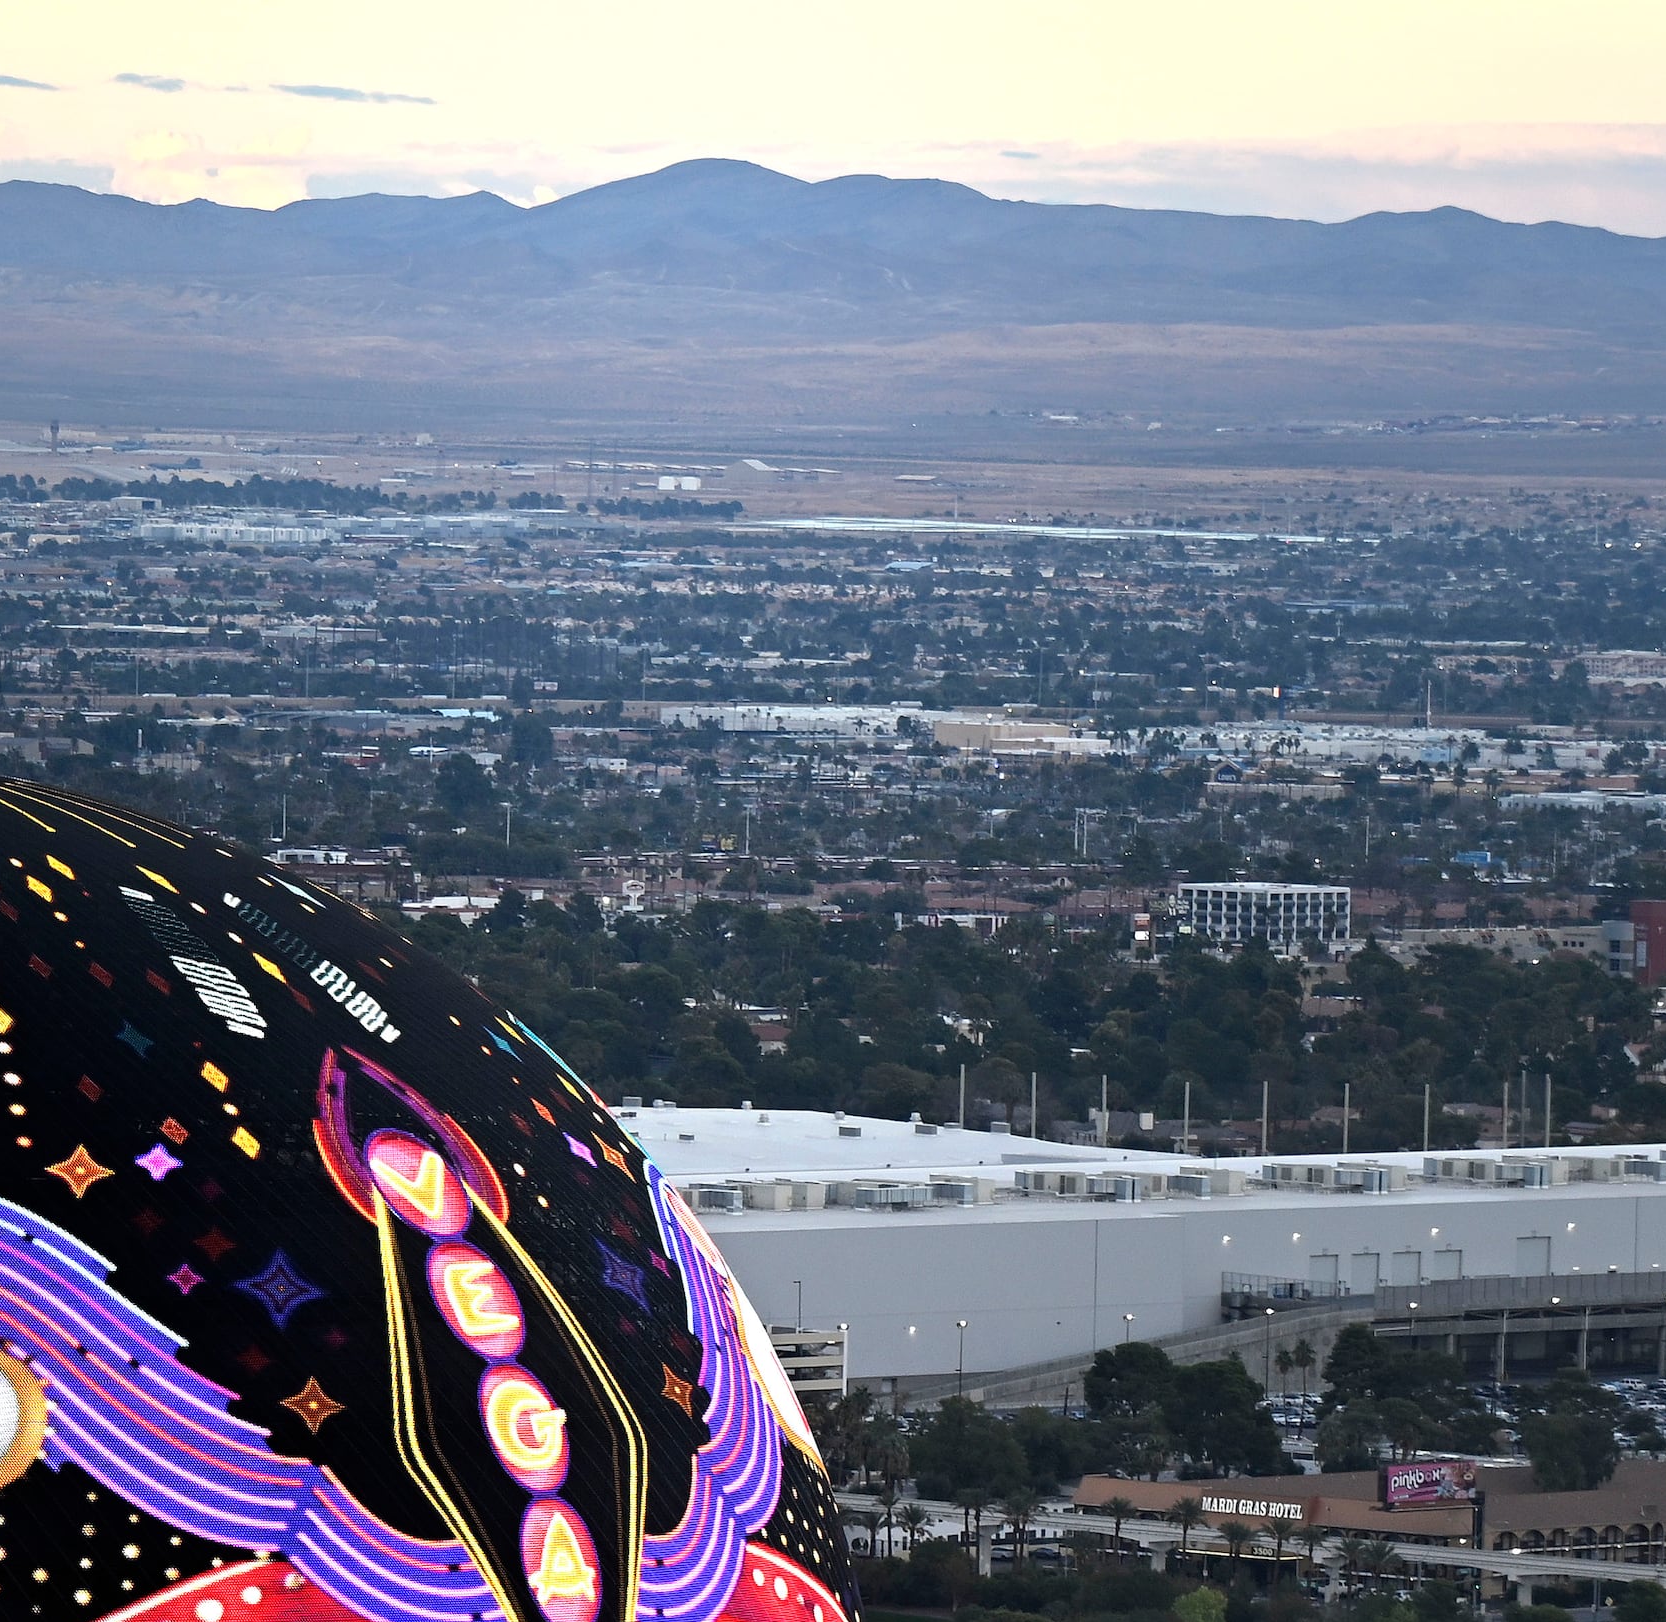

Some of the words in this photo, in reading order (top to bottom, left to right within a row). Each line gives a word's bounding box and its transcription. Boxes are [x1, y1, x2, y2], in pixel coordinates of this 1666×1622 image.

[1201, 1496, 1237, 1513] MARDI
[1238, 1499, 1267, 1517] GRAS
[1269, 1502, 1303, 1520] HOTEL
[1252, 1546, 1273, 1557] 3500
